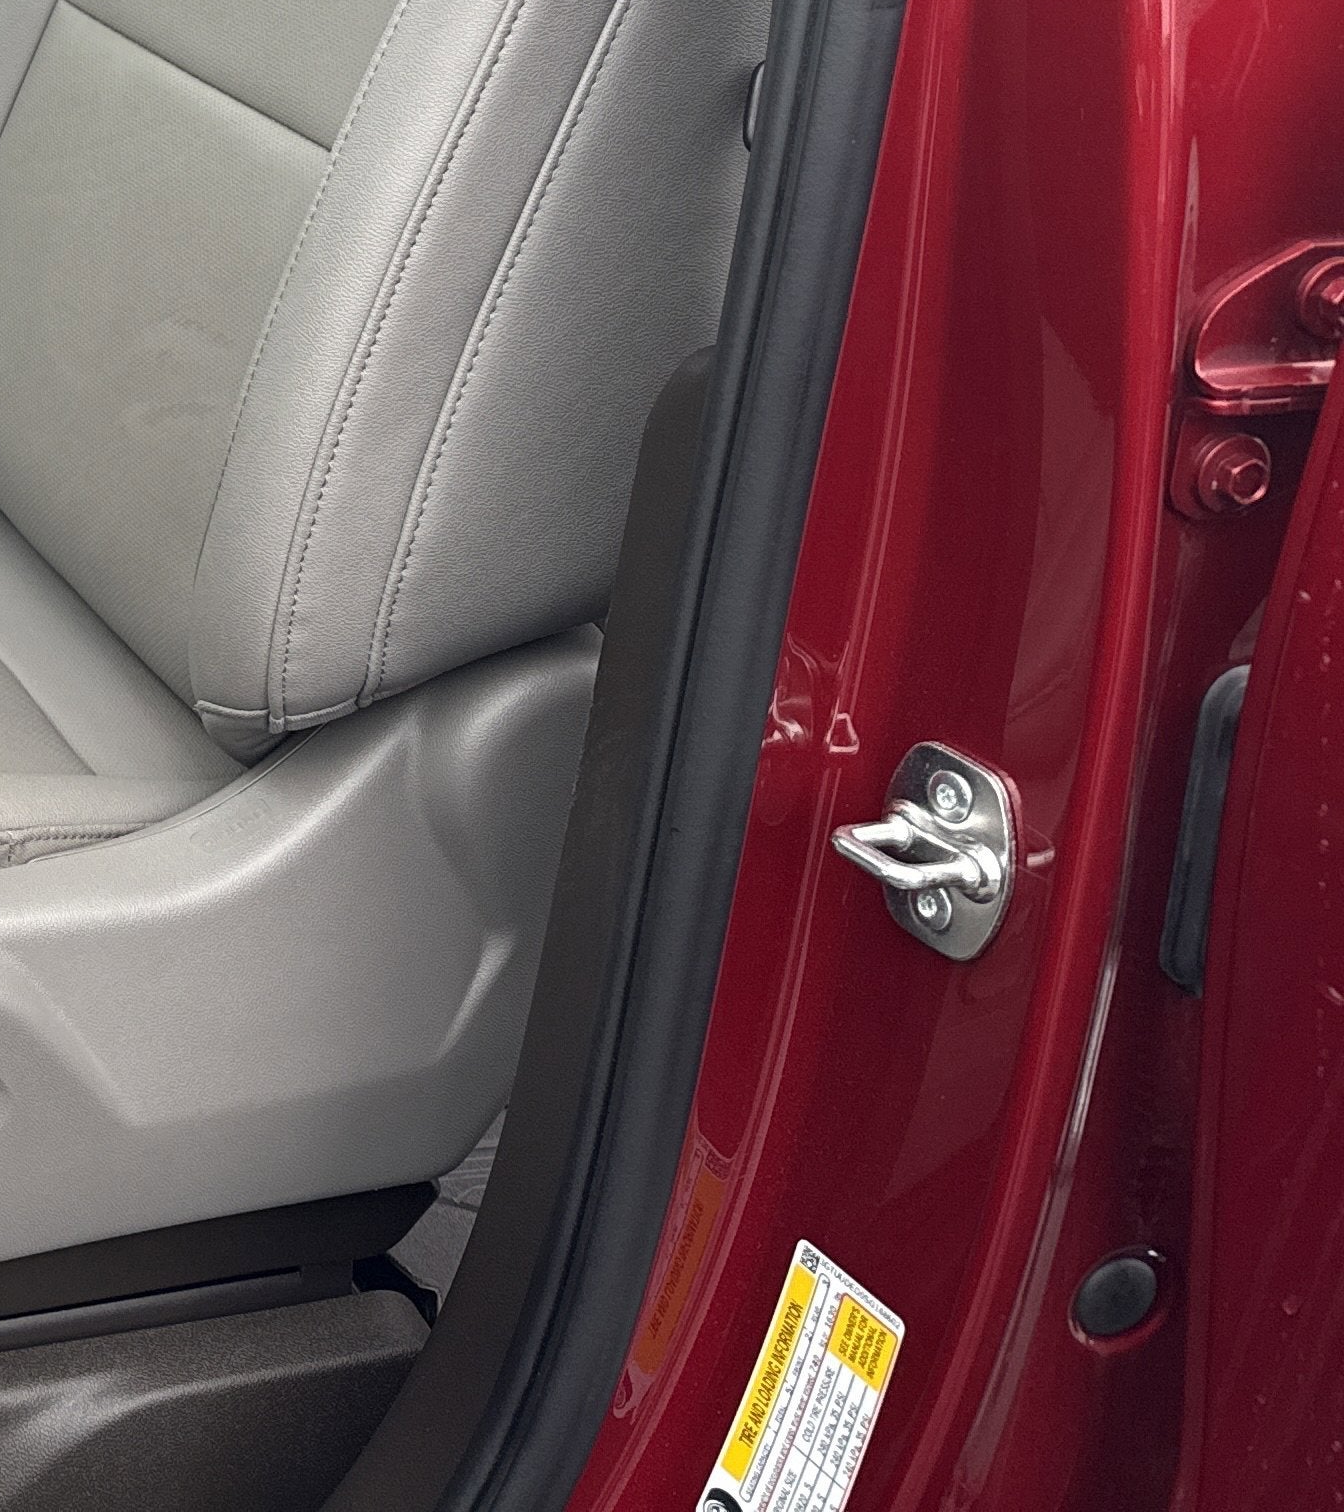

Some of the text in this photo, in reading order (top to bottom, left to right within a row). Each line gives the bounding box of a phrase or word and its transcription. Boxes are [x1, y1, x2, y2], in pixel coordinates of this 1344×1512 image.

[837, 1337, 850, 1357] SEE
[846, 1312, 870, 1364] MANUAL FOR
[855, 1322, 878, 1369] ADDITIONAL
[864, 1327, 889, 1381] INFORMATION
[737, 1297, 804, 1451] TIRE AND LOADING INFORMATION
[800, 1364, 835, 1444] COLD TIRE PRESSURE
